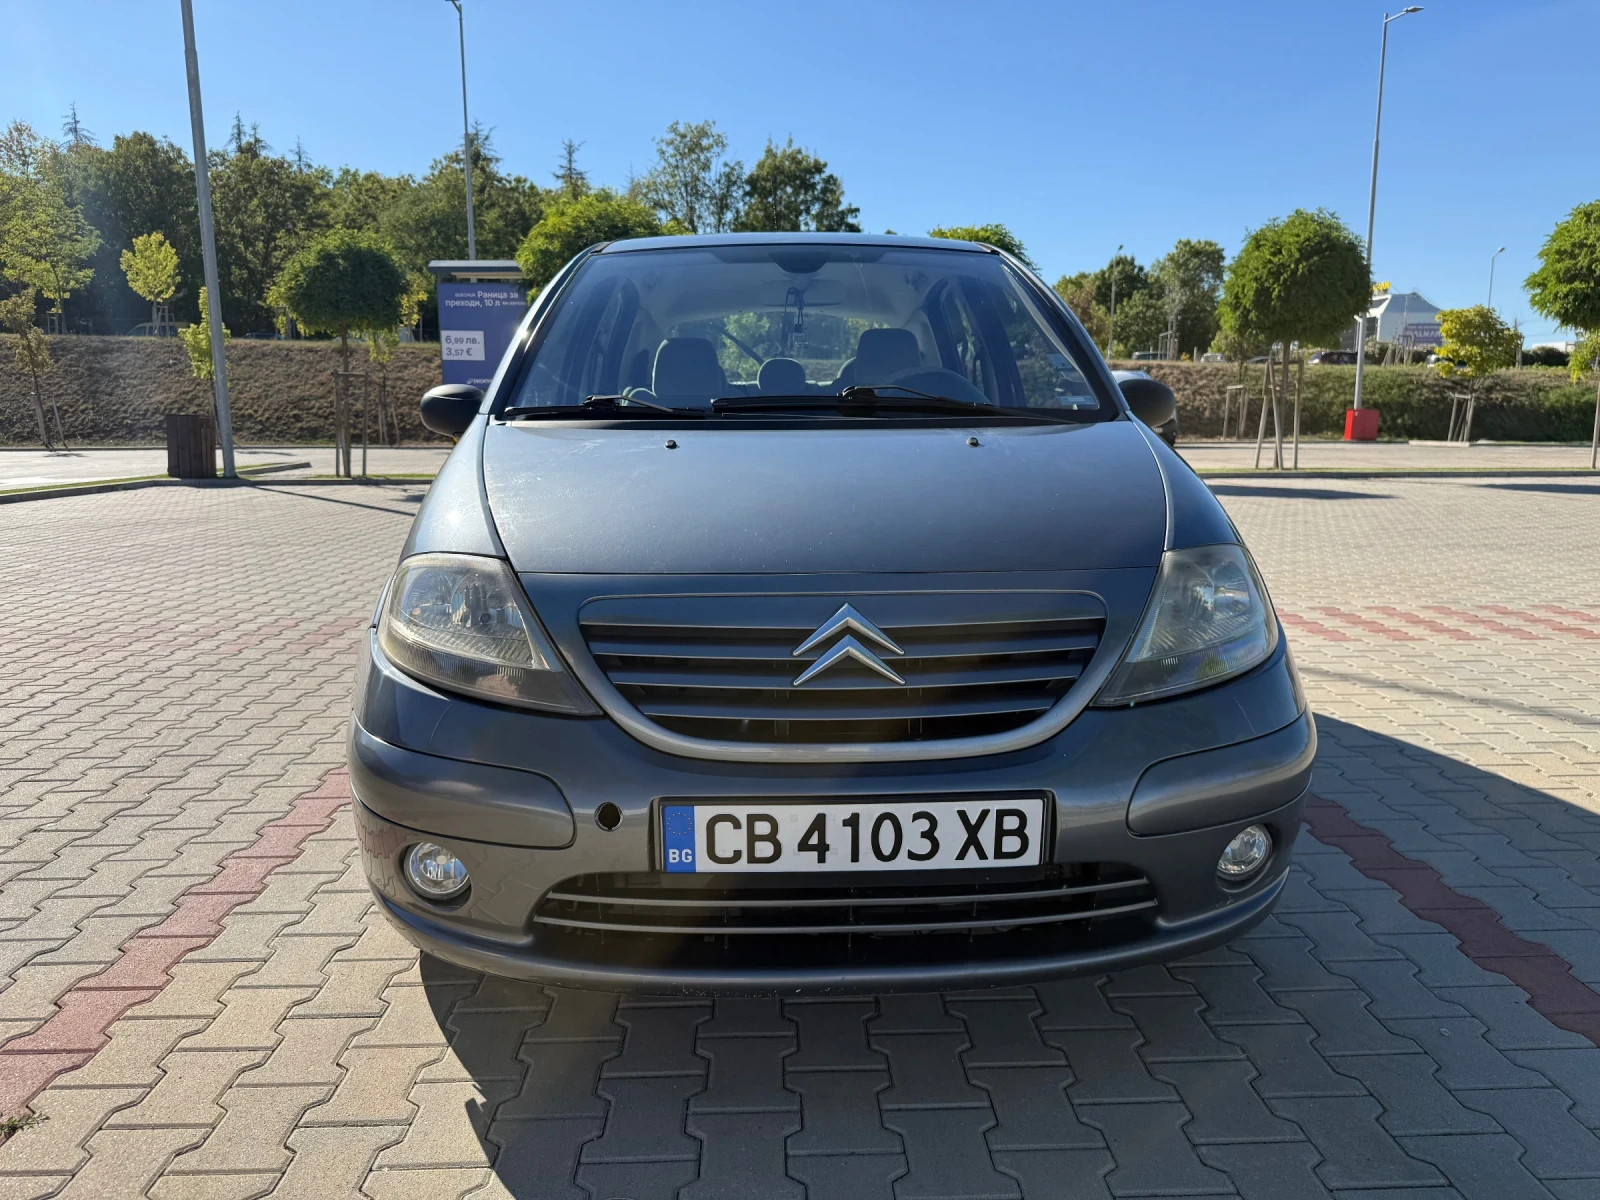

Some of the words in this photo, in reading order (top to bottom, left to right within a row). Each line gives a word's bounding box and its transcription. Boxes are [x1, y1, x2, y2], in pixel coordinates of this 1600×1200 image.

[477, 291, 508, 300] Раница
[445, 299, 483, 308] преходи,
[484, 299, 493, 307] 10
[445, 335, 464, 346] 6,99
[465, 337, 481, 345] лв.
[446, 347, 464, 357] 3,57
[466, 347, 473, 356] €
[705, 812, 783, 865] CB
[797, 810, 940, 864] 4103
[954, 807, 1030, 862] XB
[668, 848, 693, 864] BG
